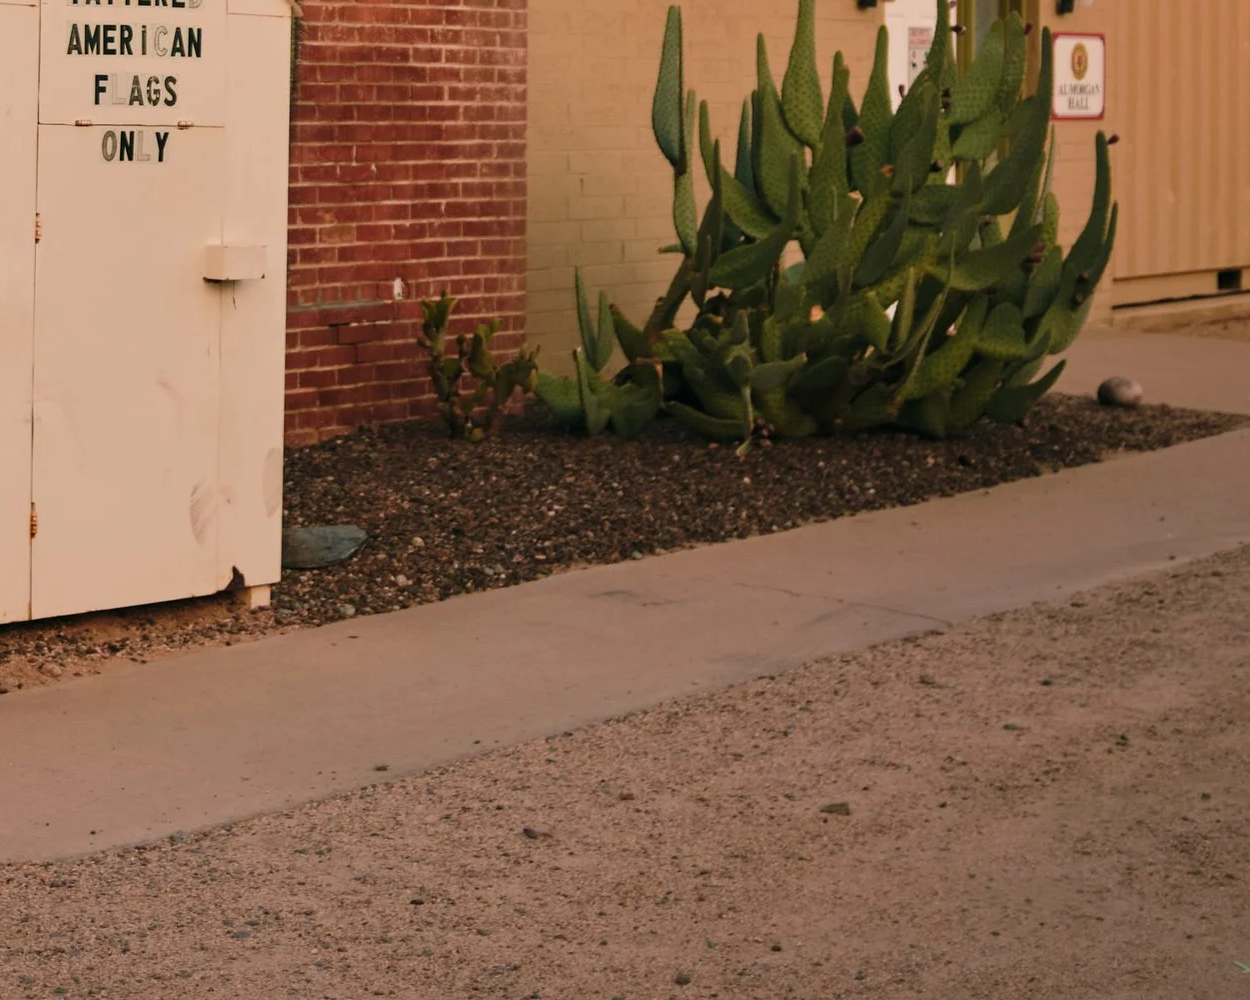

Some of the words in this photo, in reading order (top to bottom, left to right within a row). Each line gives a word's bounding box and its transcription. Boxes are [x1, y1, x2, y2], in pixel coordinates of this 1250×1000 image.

[66, 23, 203, 58] AMERICAN
[94, 74, 178, 107] FLAGS
[1068, 96, 1090, 110] HALL
[101, 130, 170, 163] ONLY
